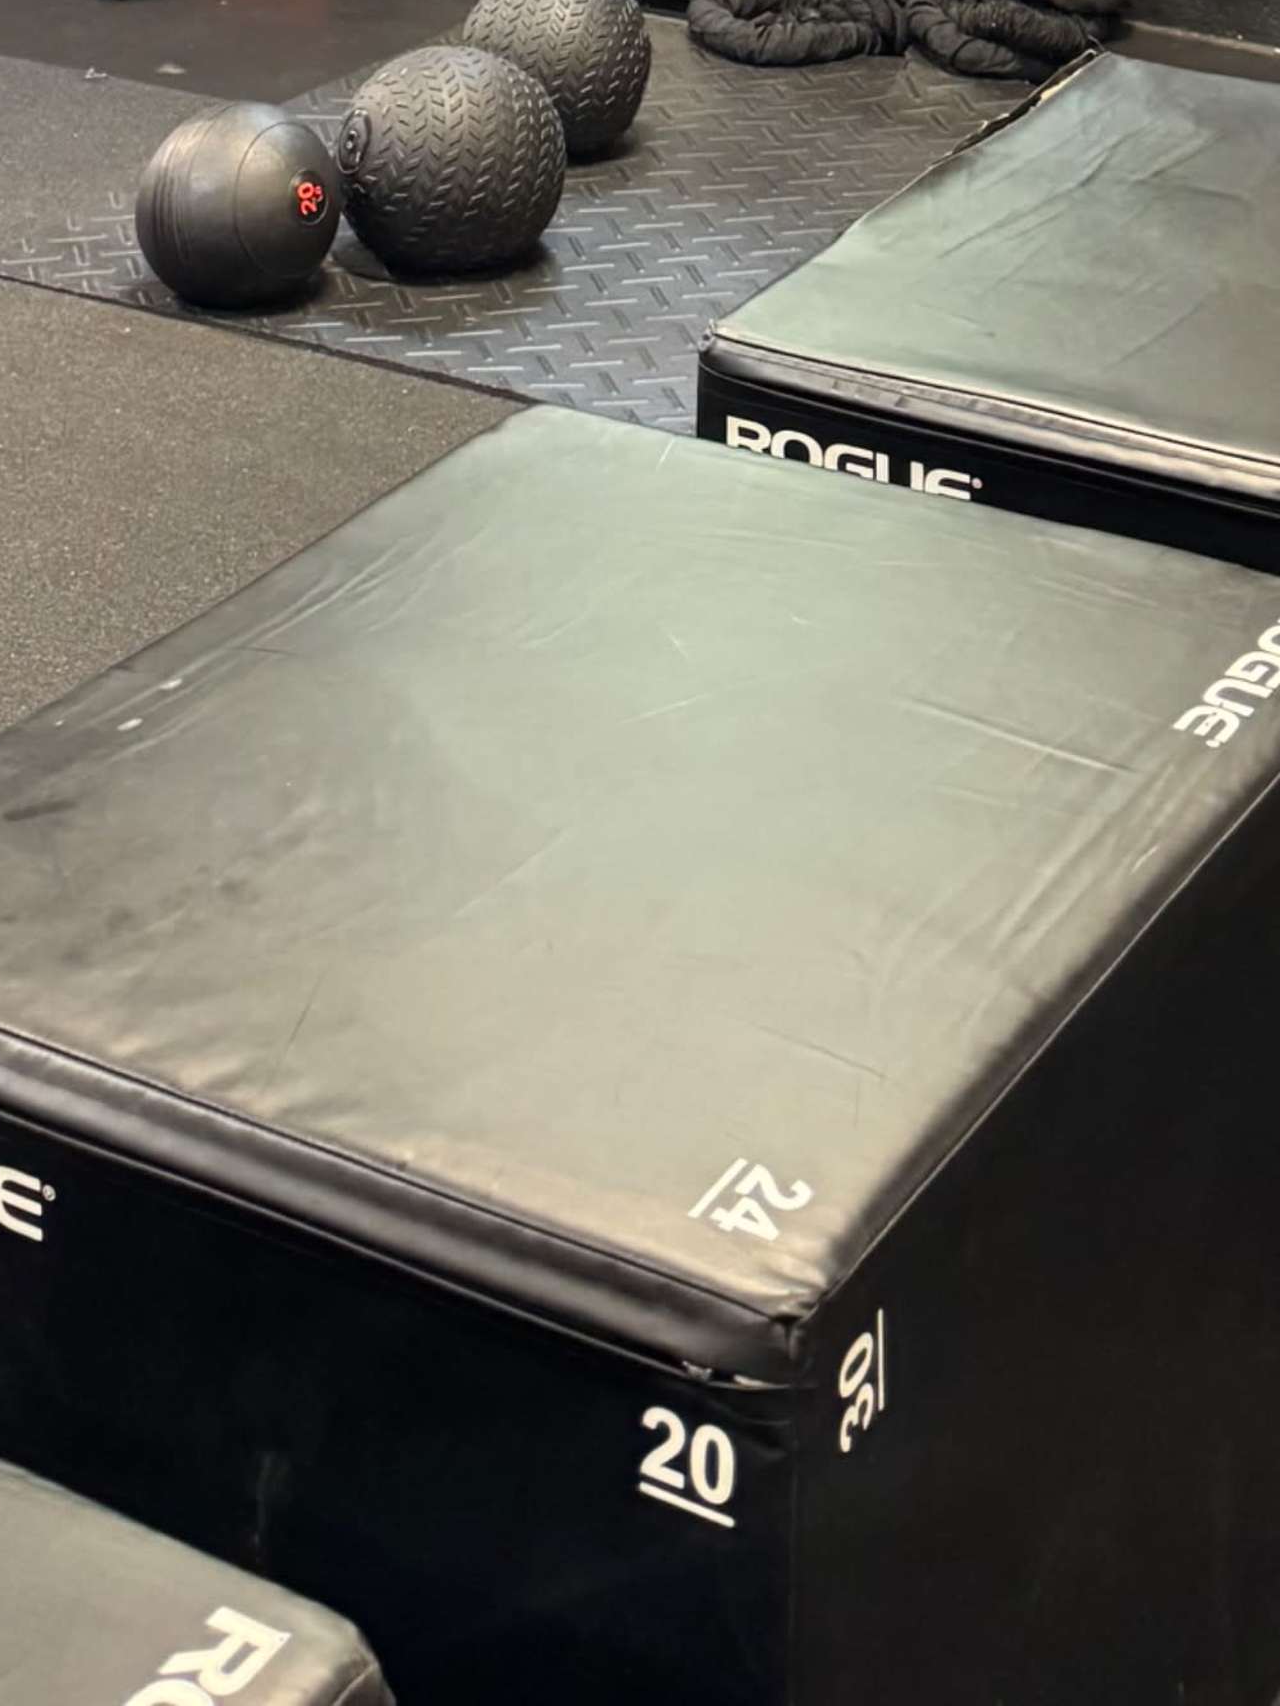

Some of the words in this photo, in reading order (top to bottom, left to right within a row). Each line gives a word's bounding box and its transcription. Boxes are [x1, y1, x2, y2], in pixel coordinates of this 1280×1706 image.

[709, 1163, 814, 1241] 24
[838, 1331, 876, 1453] 30
[640, 1406, 735, 1505] 20
